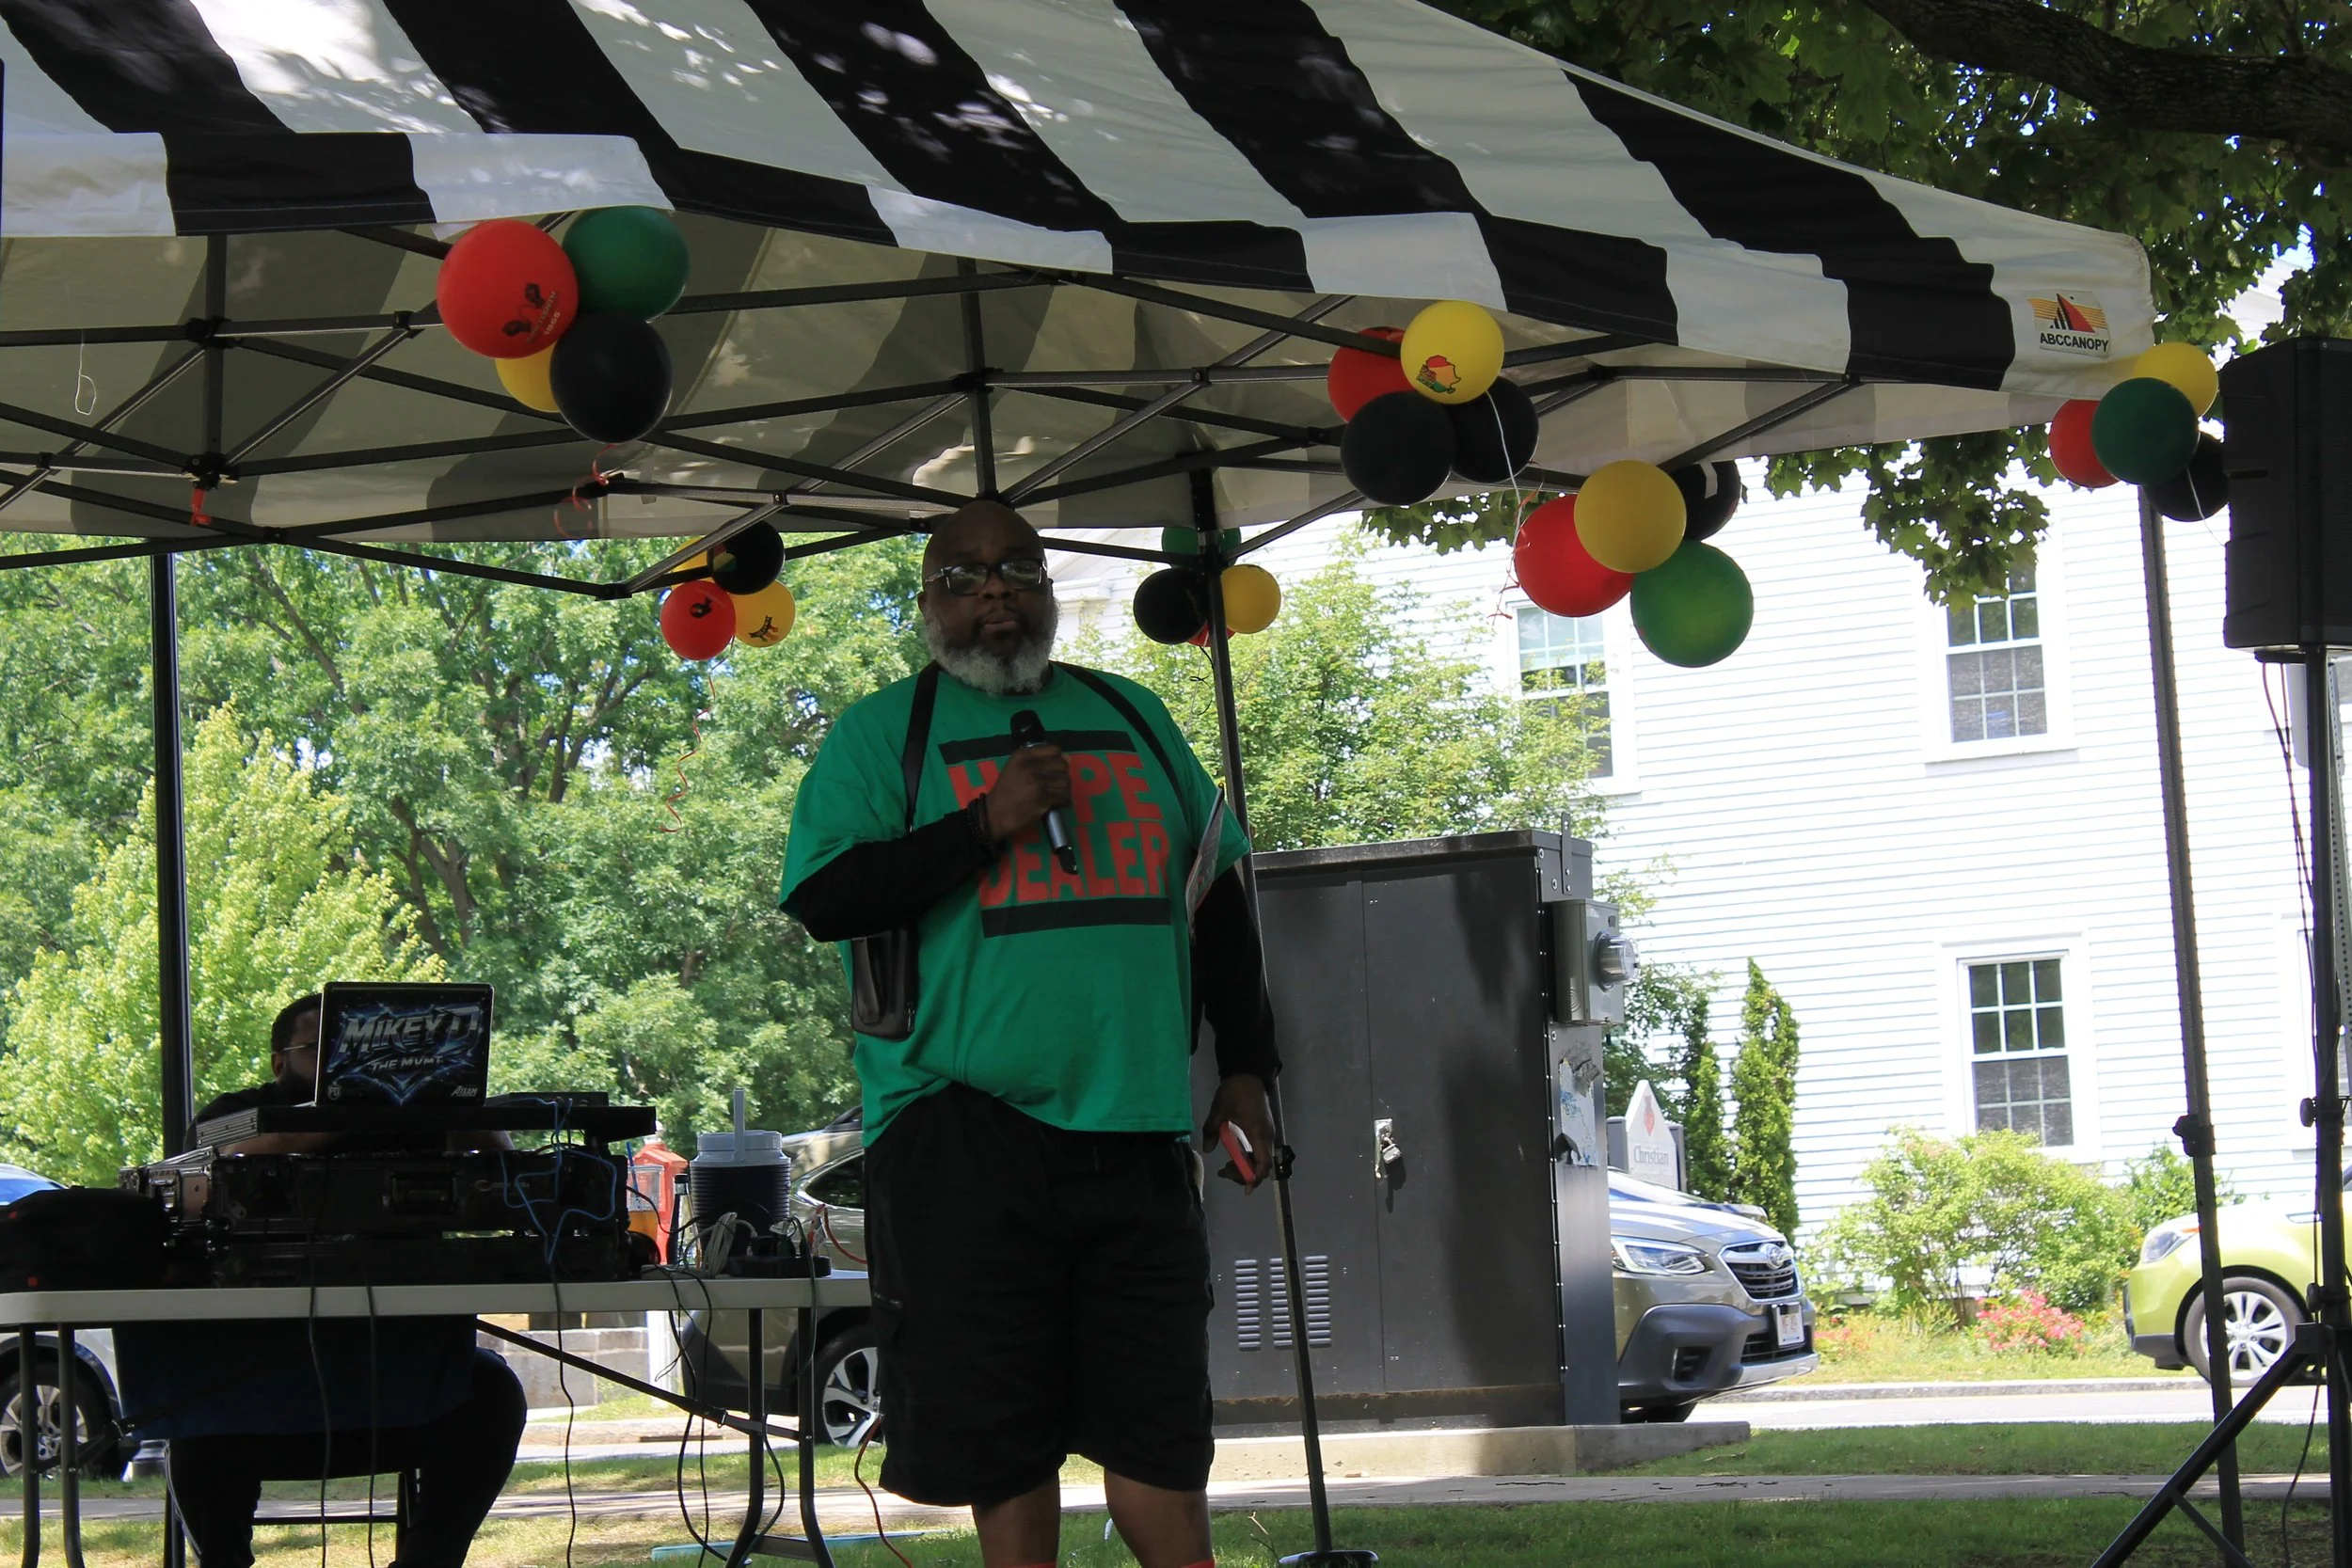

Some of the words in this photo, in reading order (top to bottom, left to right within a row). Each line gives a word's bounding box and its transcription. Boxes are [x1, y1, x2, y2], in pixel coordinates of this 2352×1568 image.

[2040, 332, 2109, 352] ABCCANOPY
[947, 752, 1165, 822] HPE
[338, 1013, 444, 1054] MIKEY
[371, 1059, 398, 1072] THE
[1632, 1144, 1670, 1166] Christian
